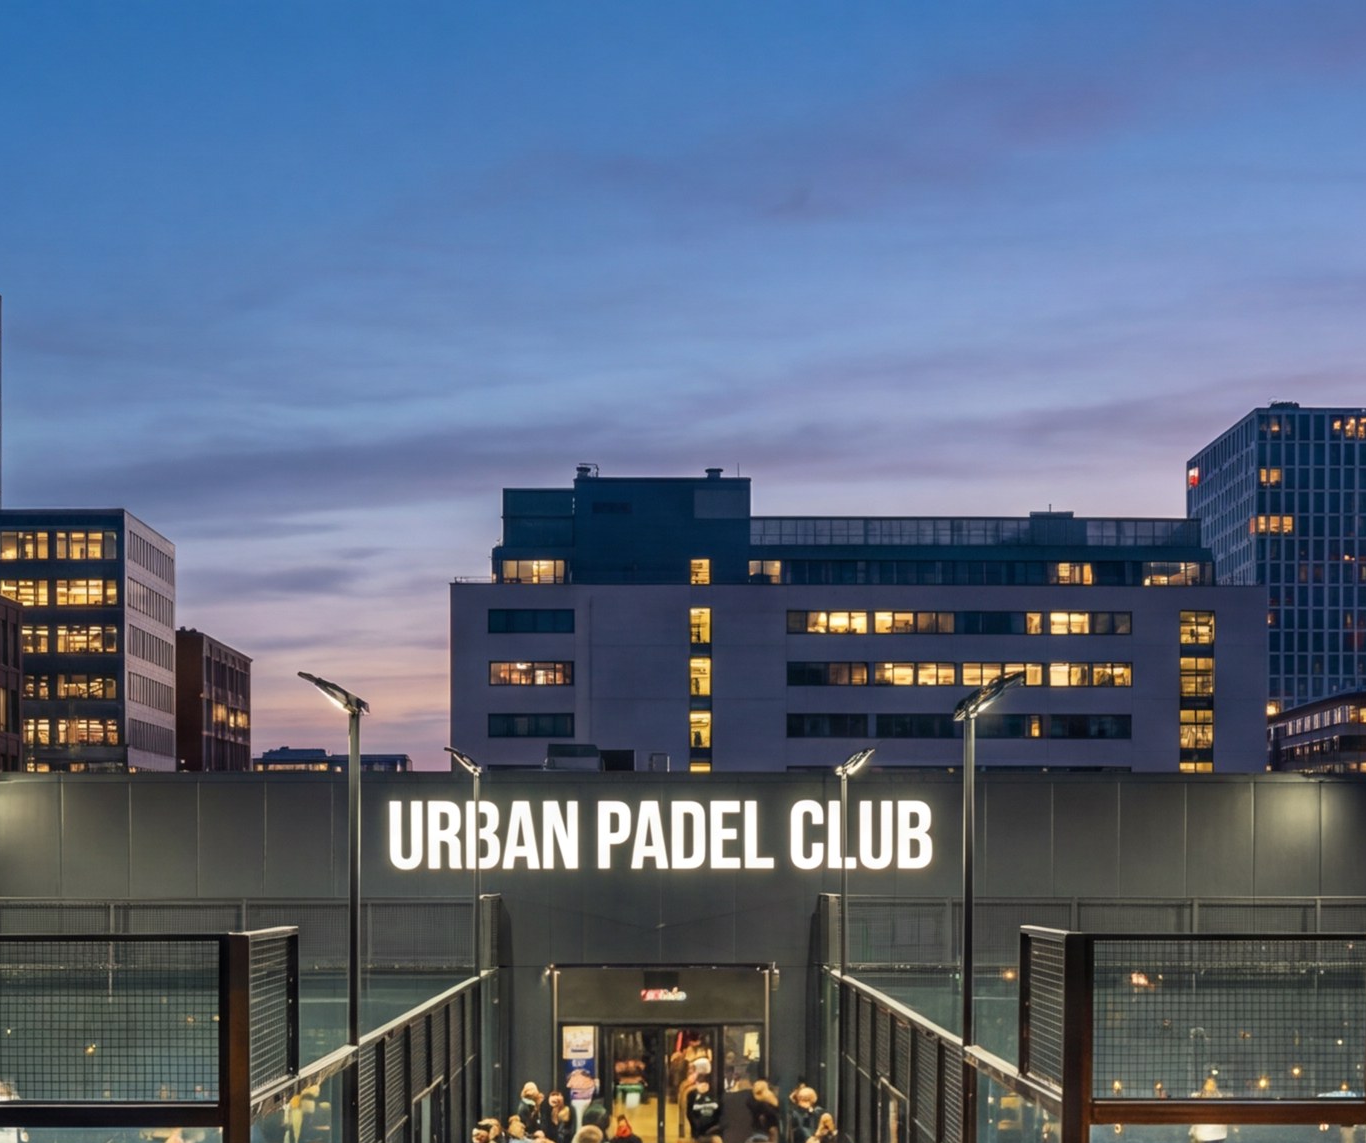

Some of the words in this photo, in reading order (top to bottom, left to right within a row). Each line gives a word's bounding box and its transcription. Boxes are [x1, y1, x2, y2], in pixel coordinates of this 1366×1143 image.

[387, 799, 580, 871] URBAN
[597, 799, 776, 871] PADEL
[789, 799, 934, 871] CLUB
